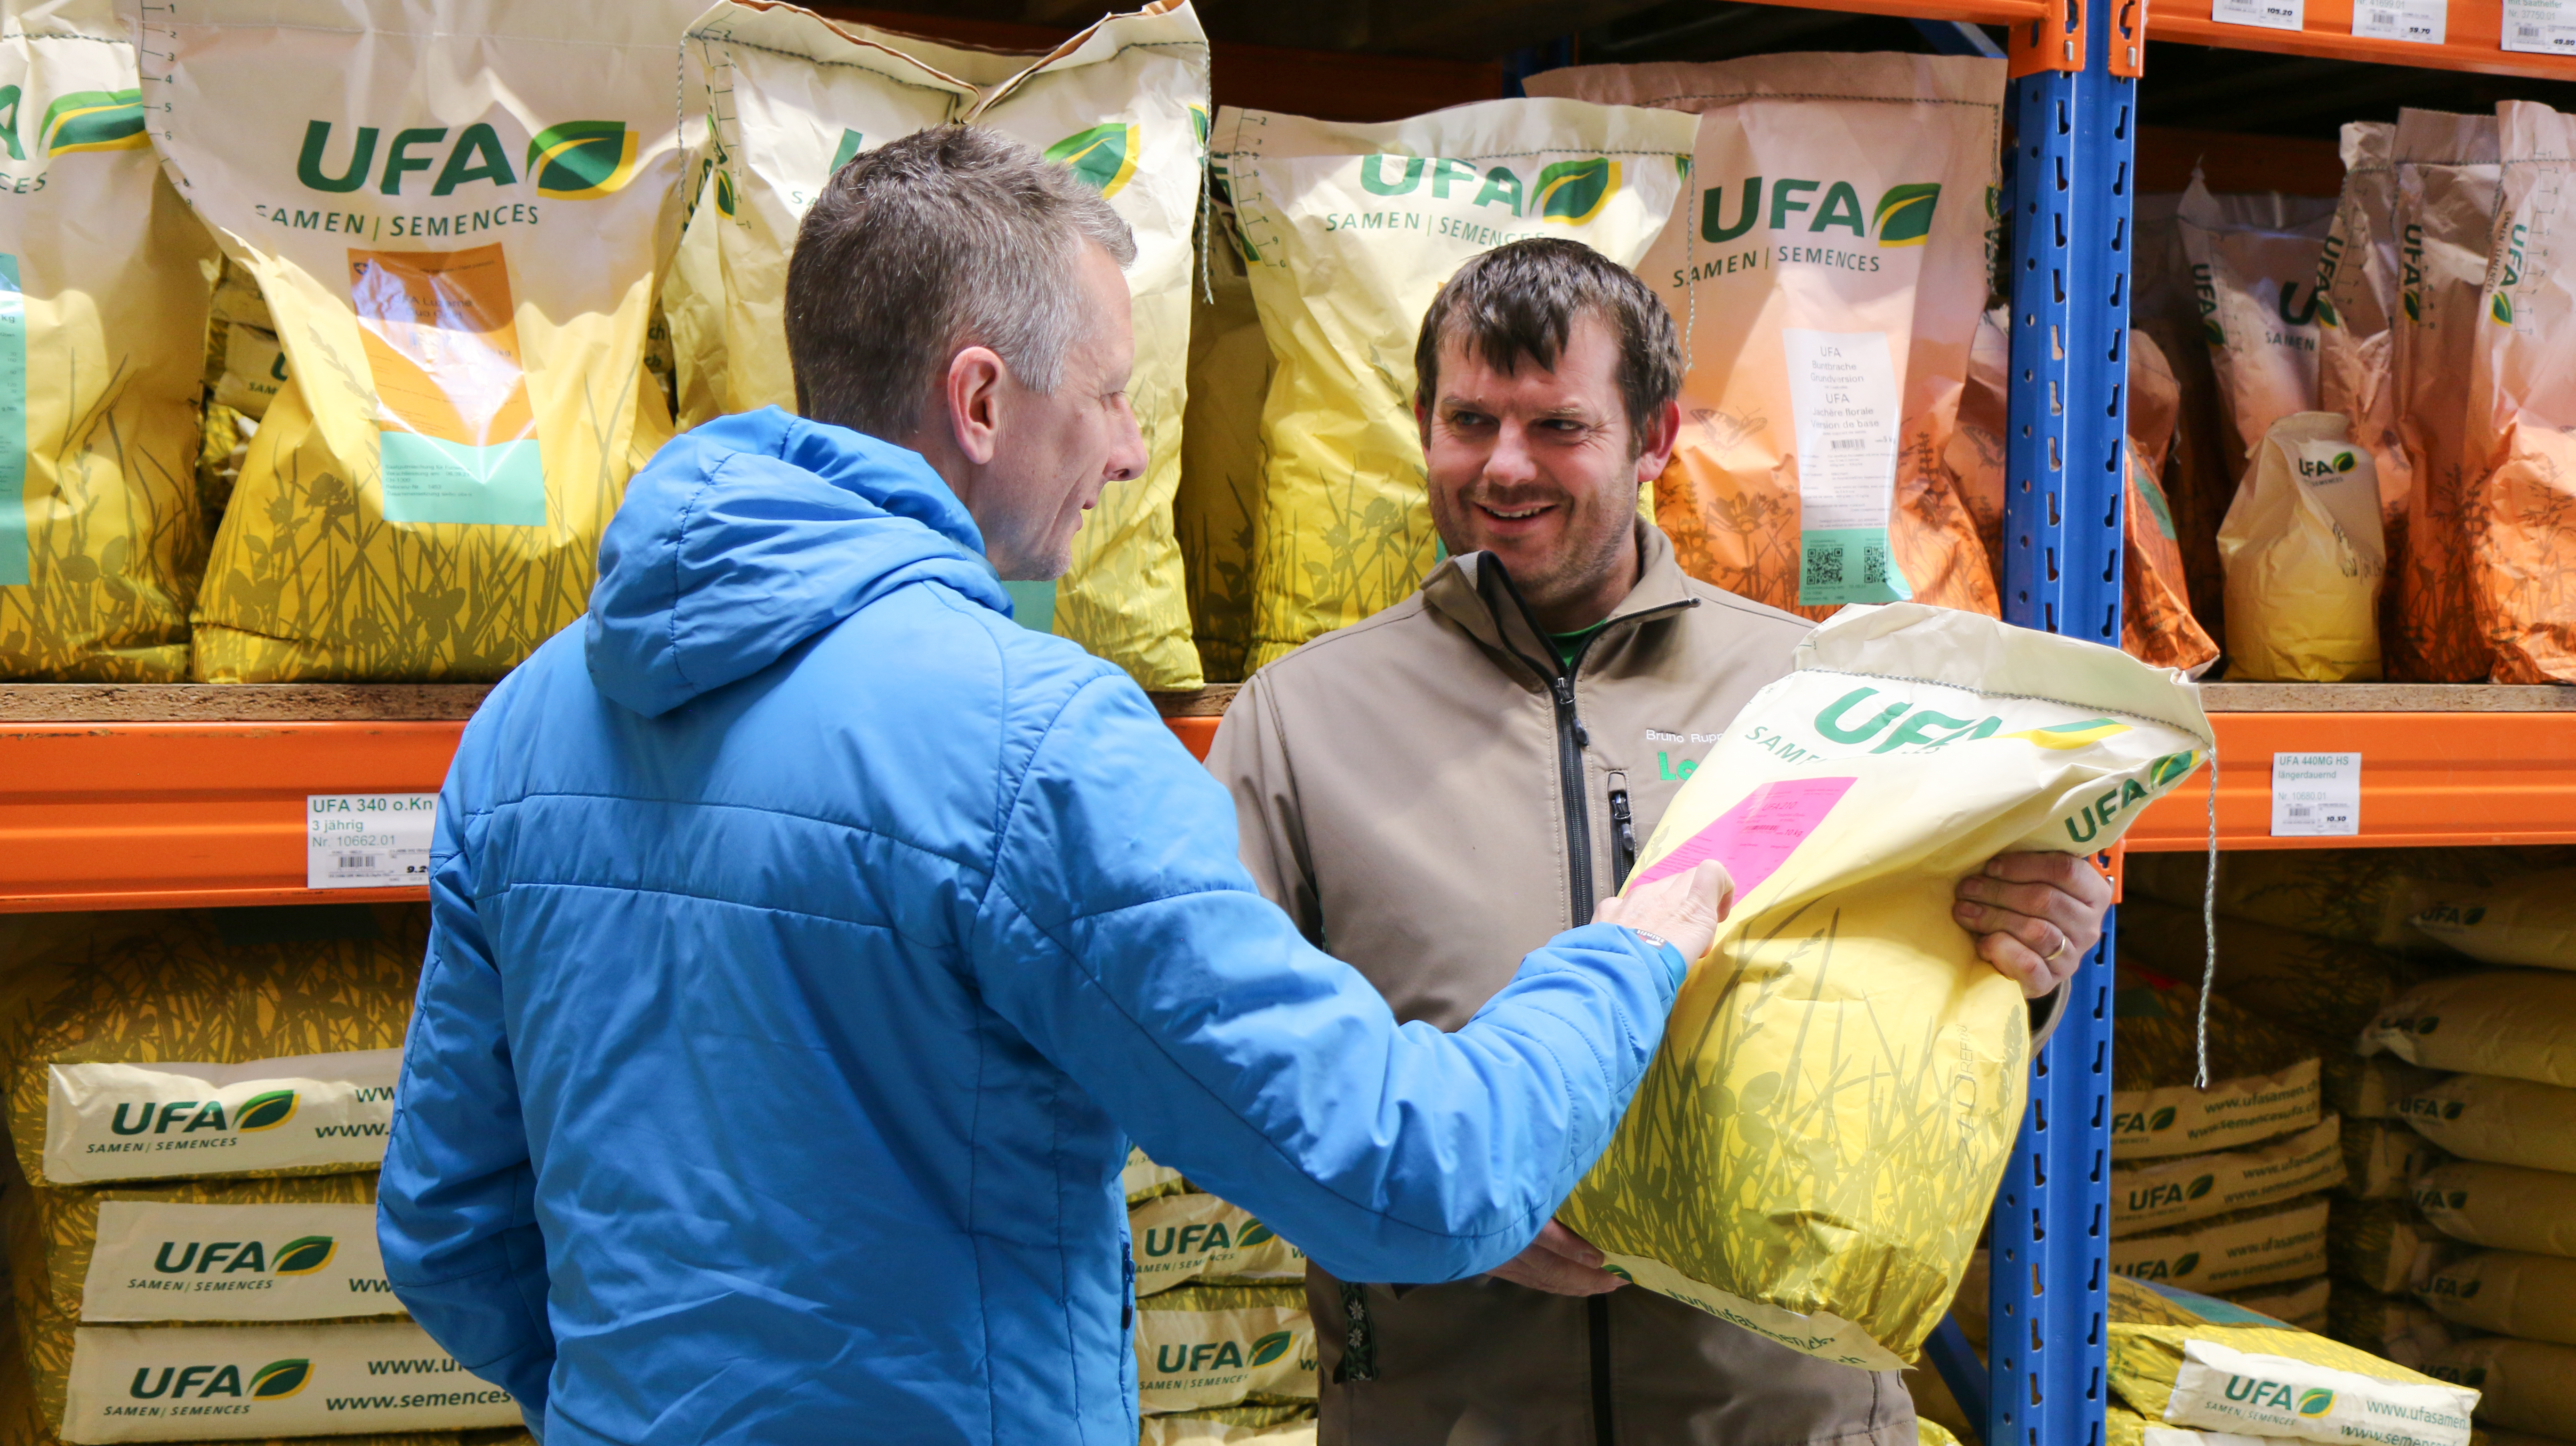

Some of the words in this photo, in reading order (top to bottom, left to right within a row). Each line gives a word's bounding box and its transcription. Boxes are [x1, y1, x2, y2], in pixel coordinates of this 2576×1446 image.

[297, 120, 517, 196] UFA
[1360, 153, 1523, 218] UFA
[255, 203, 364, 233] SAMEN
[390, 203, 539, 236] SEMENCES
[1701, 176, 1866, 243] UFA
[1325, 212, 1420, 231] SAMEN
[2317, 236, 2344, 291] UFA
[2404, 224, 2422, 286] UFA
[2500, 224, 2527, 286] UFA
[1672, 249, 1757, 288] SAMEN
[1778, 246, 1879, 273] SEMENCES
[2192, 264, 2217, 316] UFA
[1820, 346, 1842, 358] UFA
[1825, 394, 1850, 403] UFA
[1646, 729, 1684, 743] Bruno
[2279, 756, 2299, 765] UFA
[2302, 756, 2333, 765] 440MG
[2336, 756, 2349, 765] HS
[2278, 771, 2337, 780] längerdauernd
[313, 799, 350, 813] UFA
[357, 798, 386, 811] 340
[393, 797, 433, 811] o.Kn
[2064, 778, 2149, 843] UFA
[312, 820, 320, 831] 3
[323, 819, 363, 833] jährig
[313, 836, 331, 847] Nr.
[337, 835, 396, 846] 10662.01
[407, 865, 428, 873] 9.2
[111, 1100, 227, 1135] UFA
[2400, 1098, 2439, 1117] UFA
[2110, 1112, 2146, 1134] FA
[86, 1142, 144, 1154] SAMEN
[156, 1137, 237, 1151] SEMENCES
[2128, 1183, 2183, 1212] UFA
[1144, 1222, 1231, 1257] UFA
[154, 1241, 266, 1274] UFA
[1135, 1262, 1171, 1273] AMEN
[128, 1278, 183, 1291] SAMEN
[193, 1279, 274, 1292] SEMENCES
[1156, 1341, 1243, 1374] UFA
[129, 1364, 242, 1400] UFA
[1139, 1380, 1182, 1390] SAMEN
[2224, 1374, 2293, 1411] UFA
[104, 1405, 159, 1417] SAMEN
[169, 1404, 250, 1416] SEMENCES
[326, 1390, 512, 1411] www.semences
[2205, 1401, 2241, 1417] SAMEN
[2247, 1410, 2297, 1426] SEMENCES
